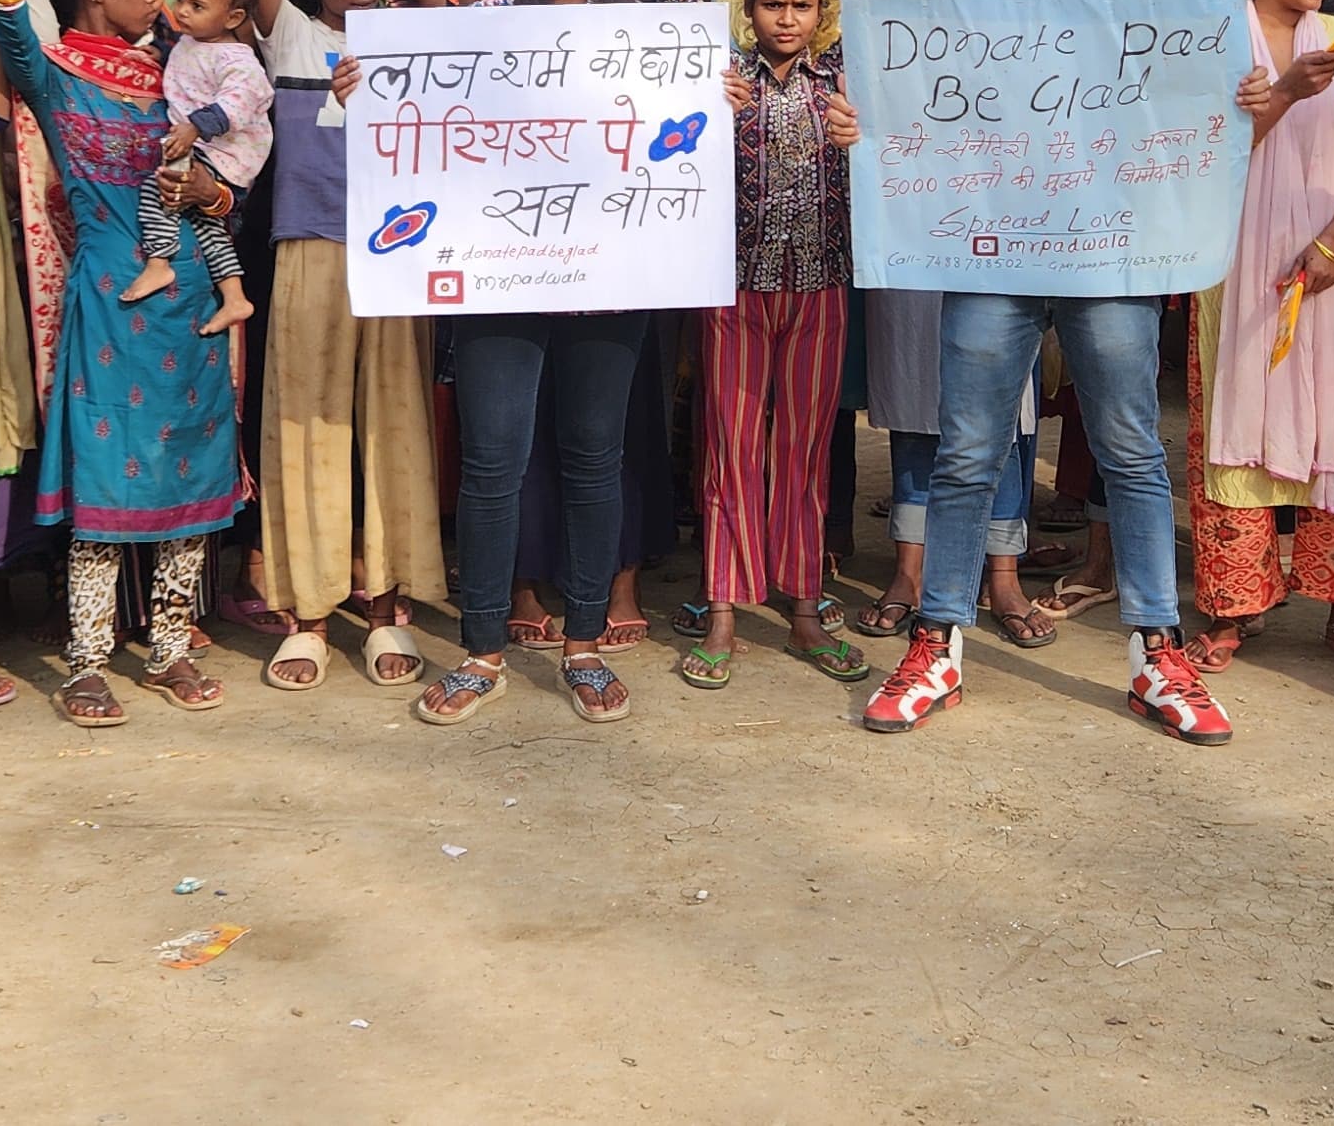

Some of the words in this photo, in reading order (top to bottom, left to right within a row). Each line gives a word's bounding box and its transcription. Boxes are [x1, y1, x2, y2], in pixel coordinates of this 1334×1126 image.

[356, 51, 493, 100] लाज
[490, 31, 575, 88] शर्म
[589, 29, 634, 79] को
[881, 19, 1076, 71] Donate
[923, 74, 1002, 122] Be
[1030, 66, 1152, 126] Glad
[597, 95, 645, 172] पे
[880, 122, 932, 165] हमें
[1046, 131, 1076, 163] पैड
[1090, 128, 1117, 155] की
[482, 183, 590, 237] सब
[601, 162, 707, 230] बोलो
[881, 176, 938, 198] 5000
[1010, 165, 1035, 191] की
[929, 205, 1050, 240] Spread
[1067, 207, 1134, 232] Love
[1006, 234, 1130, 256] mrpadwala
[473, 268, 587, 291] mrpadwala
